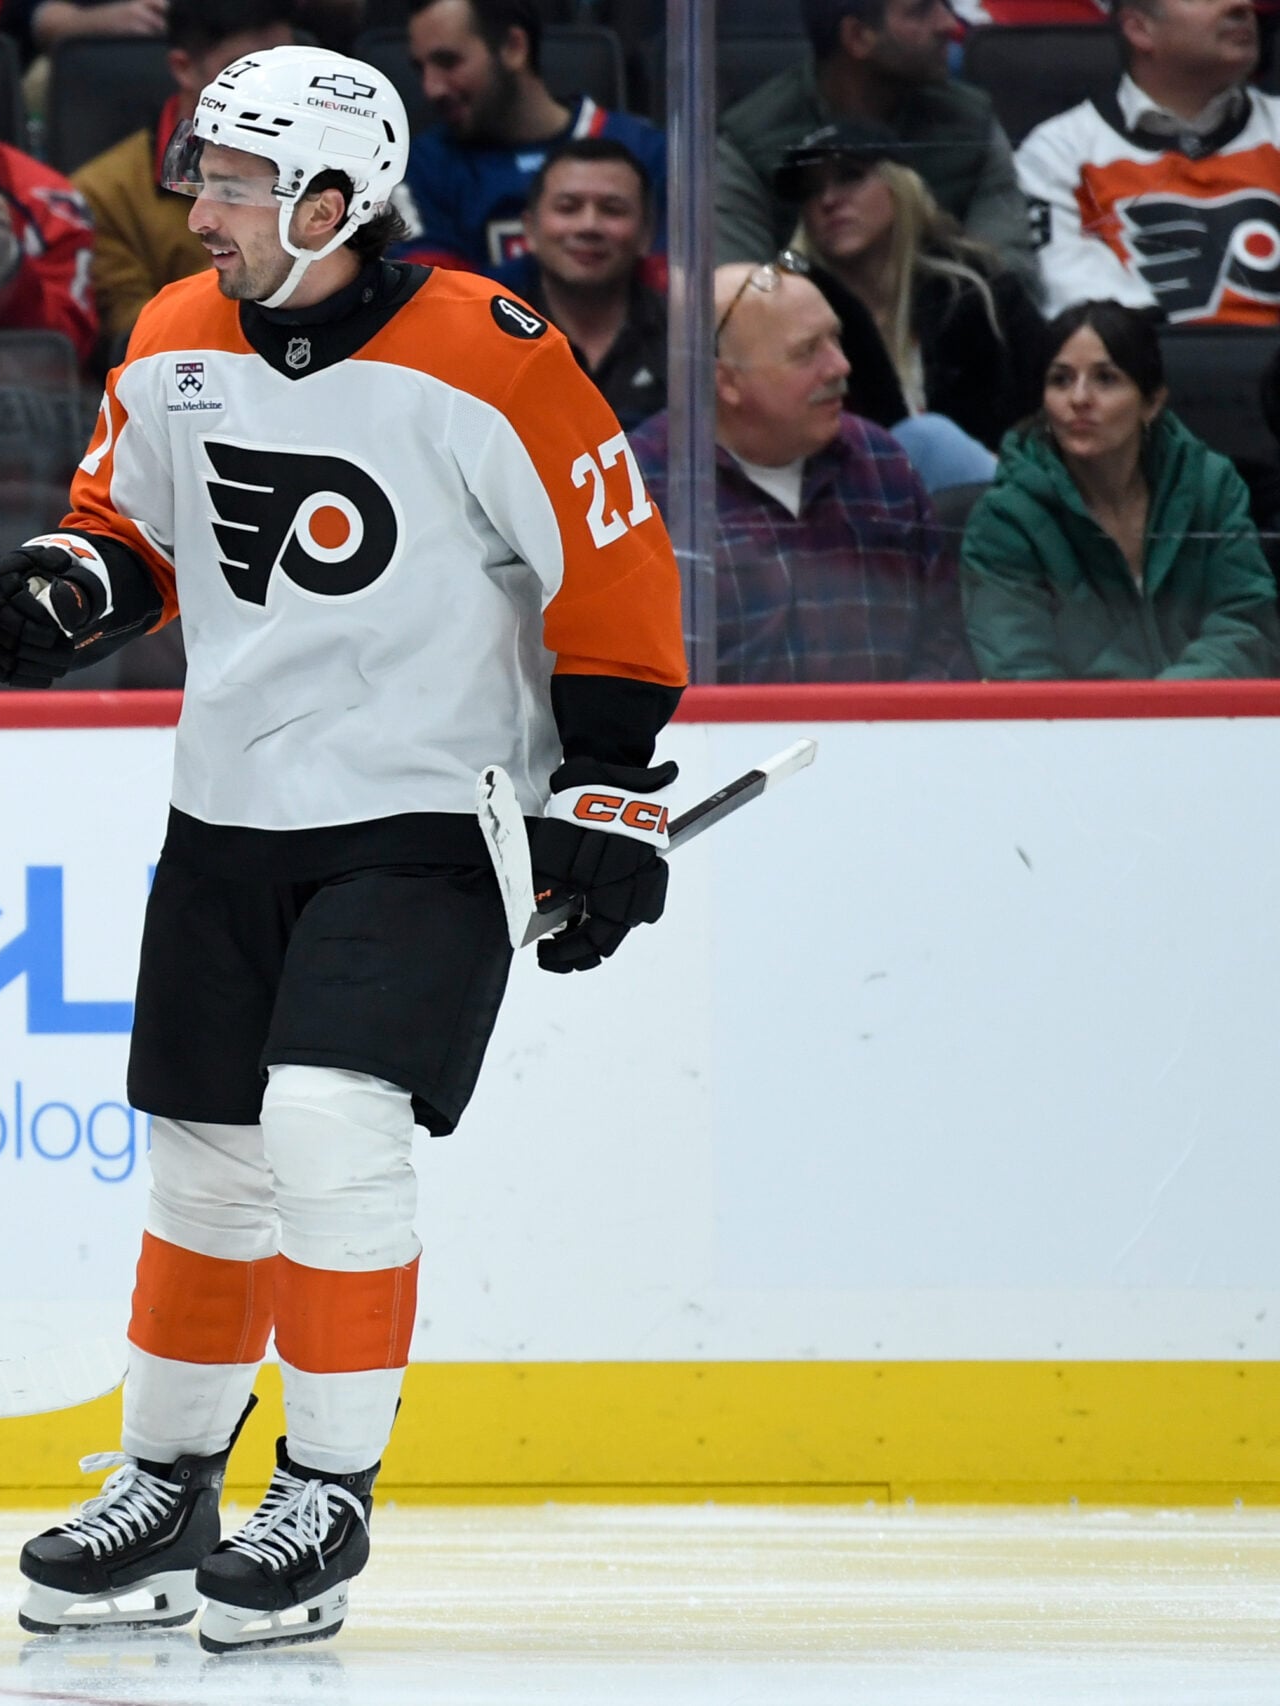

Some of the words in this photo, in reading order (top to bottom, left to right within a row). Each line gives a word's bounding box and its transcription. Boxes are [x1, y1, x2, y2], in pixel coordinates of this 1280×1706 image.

[200, 96, 227, 113] CCM
[307, 96, 377, 120] CHEVROLET
[182, 399, 223, 411] Medicine
[570, 430, 653, 550] 27
